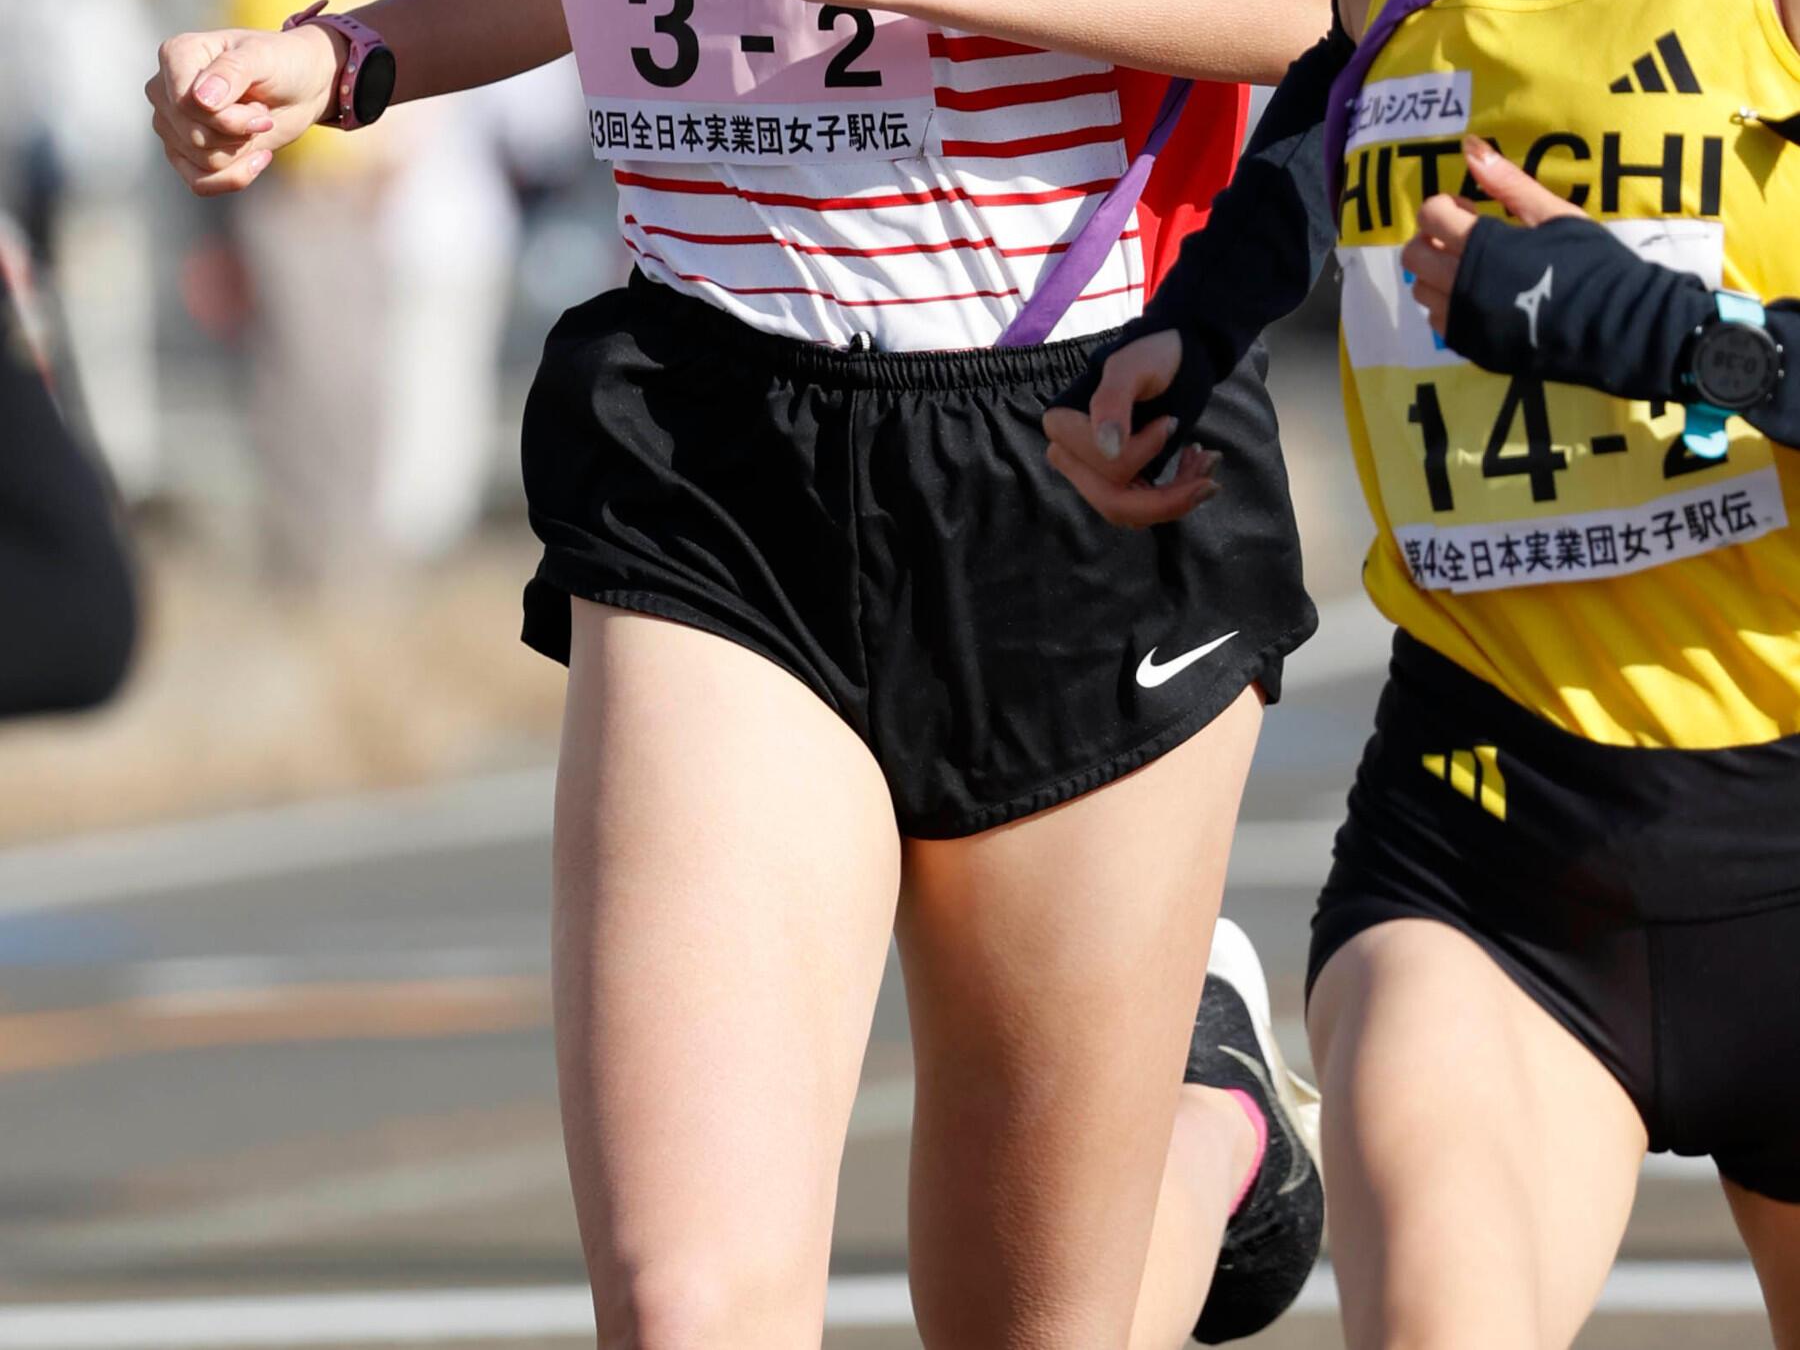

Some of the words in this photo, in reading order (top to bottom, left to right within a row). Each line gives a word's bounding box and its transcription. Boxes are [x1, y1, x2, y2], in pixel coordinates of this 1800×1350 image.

[1347, 88, 1464, 136] ビルシステム
[1405, 491, 1757, 583] 第4全日本実業団女子駅伝
